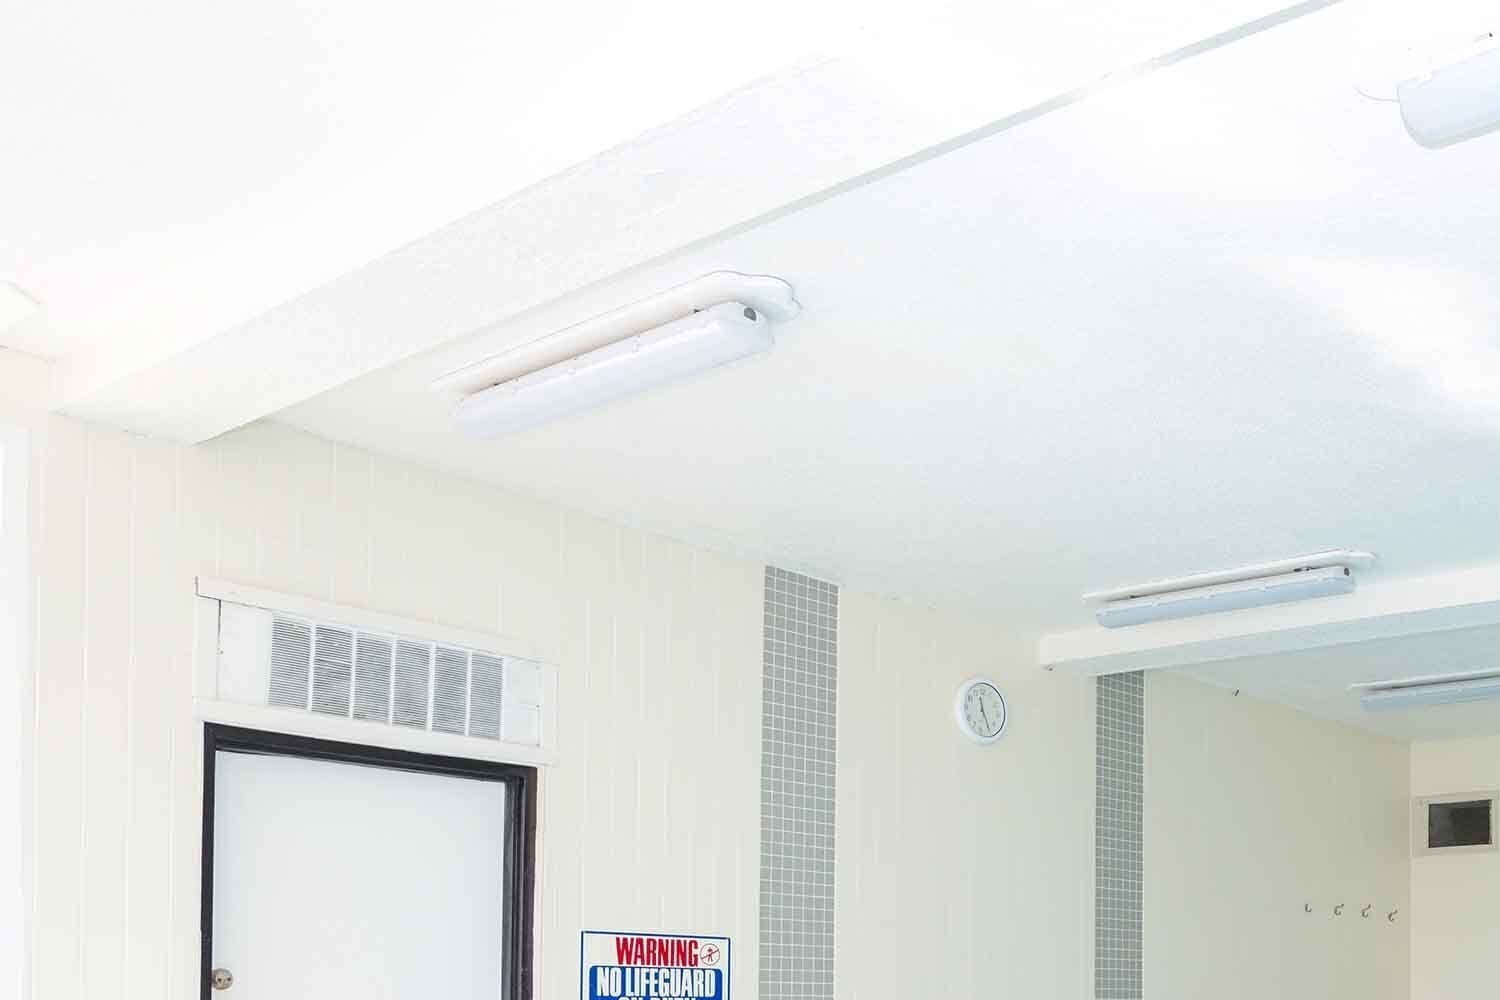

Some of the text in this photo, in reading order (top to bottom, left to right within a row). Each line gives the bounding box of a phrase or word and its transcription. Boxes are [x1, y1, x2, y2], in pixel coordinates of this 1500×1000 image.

[615, 936, 699, 967] WARNING
[596, 966, 716, 998] NO LIFEGUARD
